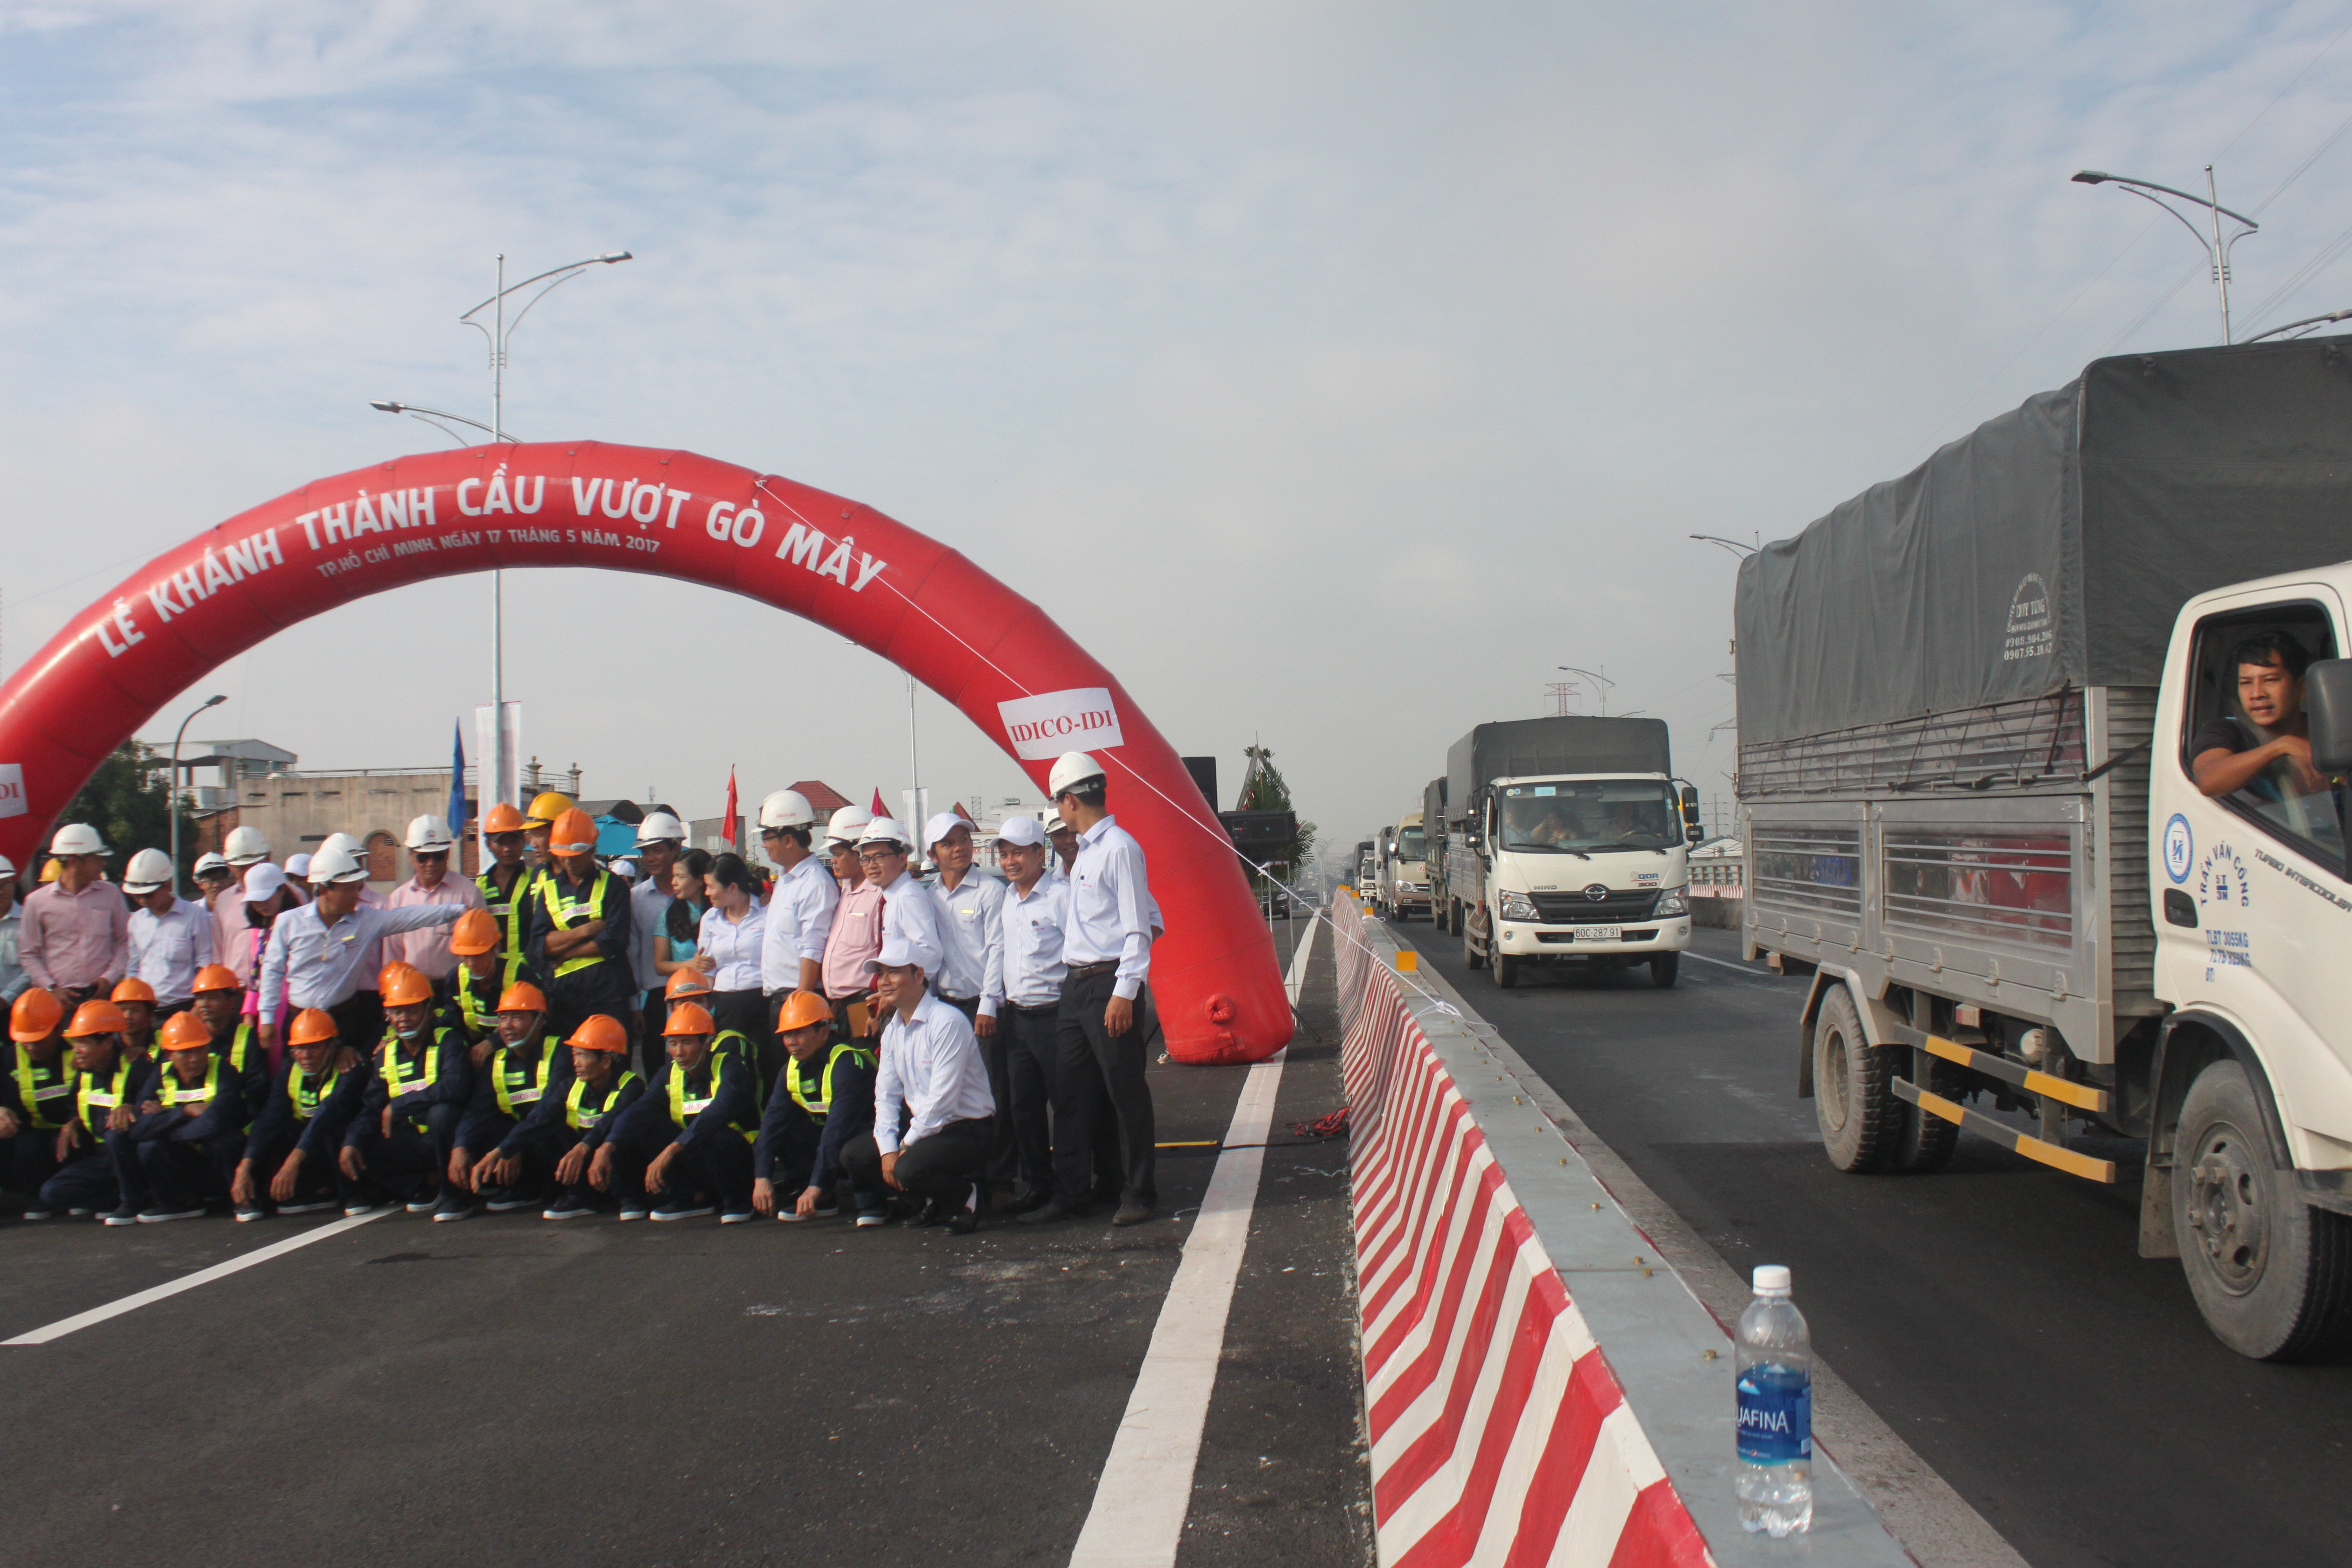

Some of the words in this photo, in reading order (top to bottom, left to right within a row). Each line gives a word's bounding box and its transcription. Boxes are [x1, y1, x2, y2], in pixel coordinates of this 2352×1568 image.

[96, 596, 146, 658] LỄ
[146, 528, 285, 623] KHÁNH
[296, 489, 437, 550] THÀNH
[457, 462, 544, 517] CẦU
[571, 477, 690, 529] VƯỢT
[706, 499, 765, 547] GÒ
[775, 536, 887, 592] MÂY
[364, 543, 391, 563] CHÍ
[439, 530, 482, 549] NGÀY
[486, 530, 501, 543] 17
[507, 526, 561, 542] THÁNG
[566, 529, 576, 542] 5
[581, 529, 618, 546] NĂM
[626, 535, 660, 553] 2017
[1009, 710, 1114, 742] IDICO-IDI
[2254, 848, 2285, 872] TURBO
[1575, 928, 1618, 937] 60C-287.91
